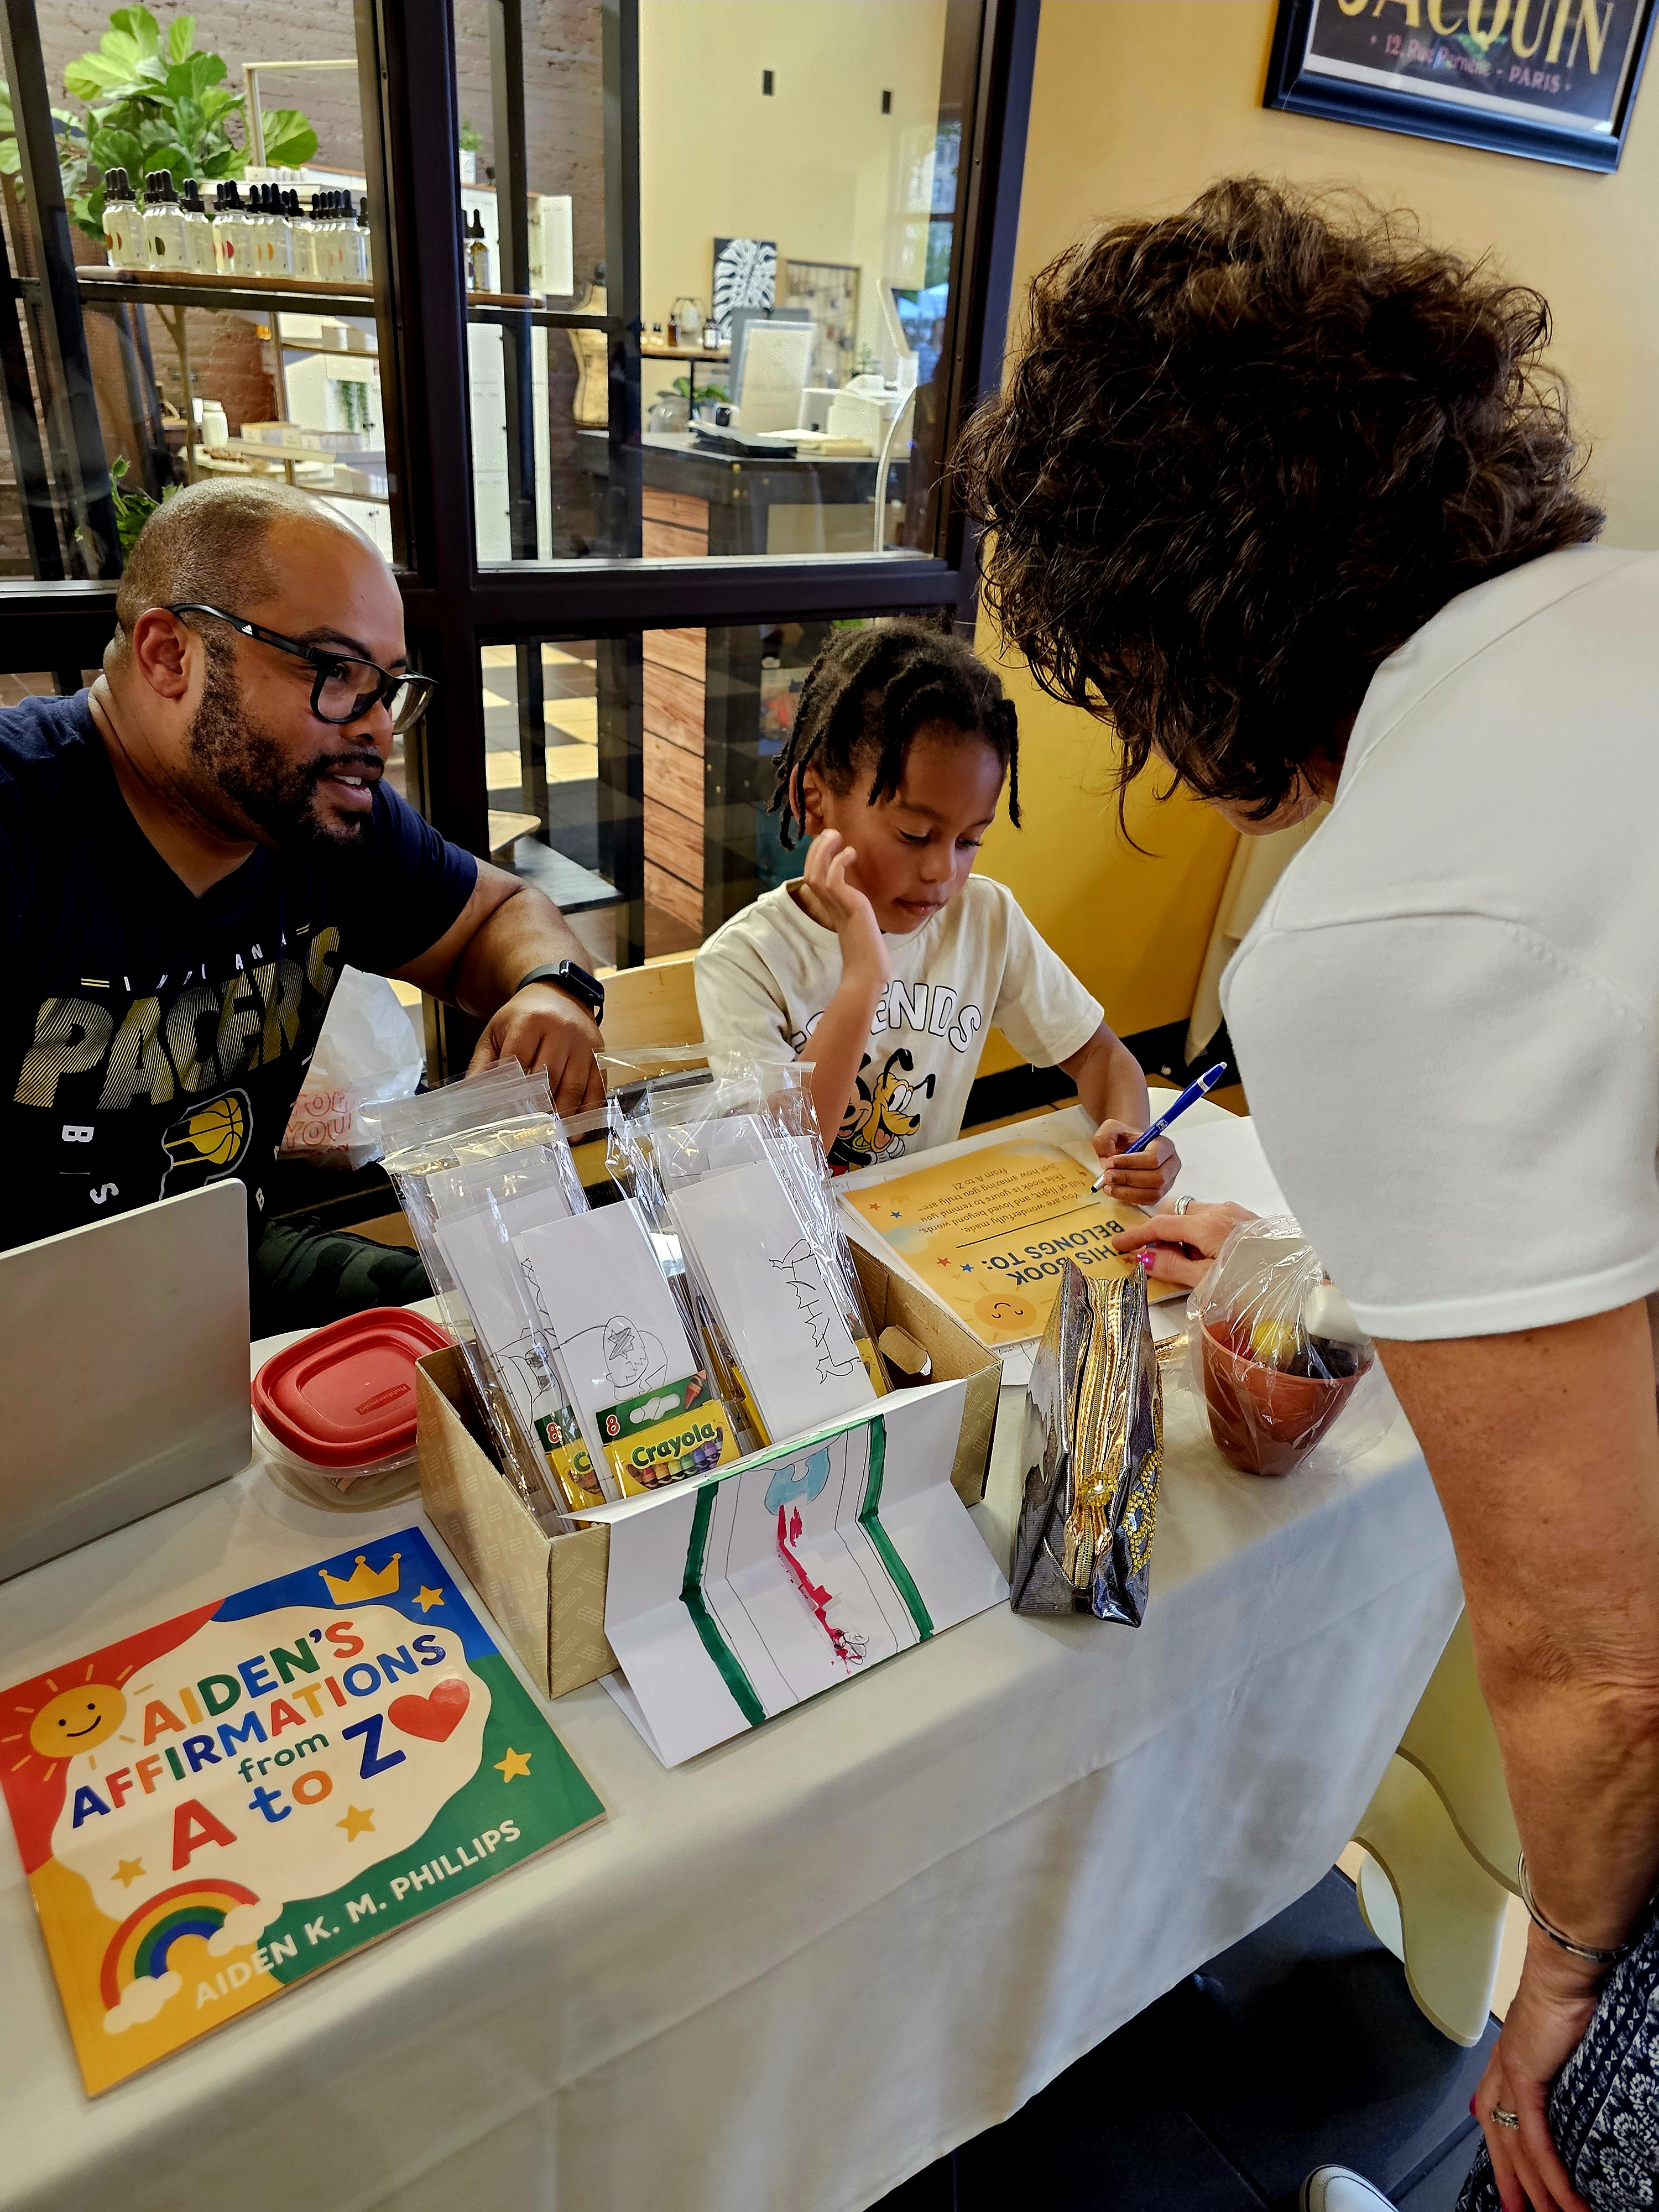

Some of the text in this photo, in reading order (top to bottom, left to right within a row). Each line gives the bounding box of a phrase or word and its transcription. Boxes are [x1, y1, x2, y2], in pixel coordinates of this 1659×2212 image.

[1509, 66, 1562, 94] PARIS
[13, 926, 340, 1109] PACERS
[980, 1175, 1019, 1191] amazing
[984, 1167, 1008, 1178] from
[1020, 1167, 1041, 1178] how
[1045, 1173, 1067, 1182] This
[952, 1182, 965, 1191] Z!
[962, 1187, 981, 1197] you
[985, 1188, 1012, 1202] yours
[1021, 1178, 1047, 1191] book
[919, 1180, 1086, 1234] full of light, and loved beyond words.
[938, 1194, 963, 1205] truly
[940, 1202, 973, 1219] remind
[920, 1213, 939, 1222] you
[960, 1192, 1078, 1233] You are wonderfully made,
[981, 1220, 1125, 1270] BELONGS TO:
[1074, 1245, 1131, 1264] HIS
[359, 1385, 408, 1413] Rubbermaid
[546, 1422, 561, 1444] 8
[606, 1414, 620, 1436] 8
[631, 1421, 717, 1468] Crayola
[143, 1621, 364, 1746] AIDEN'S
[72, 1634, 446, 1829] AFFIRMATIONS
[237, 1732, 330, 1783] from
[173, 1714, 406, 1871] A to Z
[195, 1819, 521, 2008] AIDEN K. M. PHILLIPS
